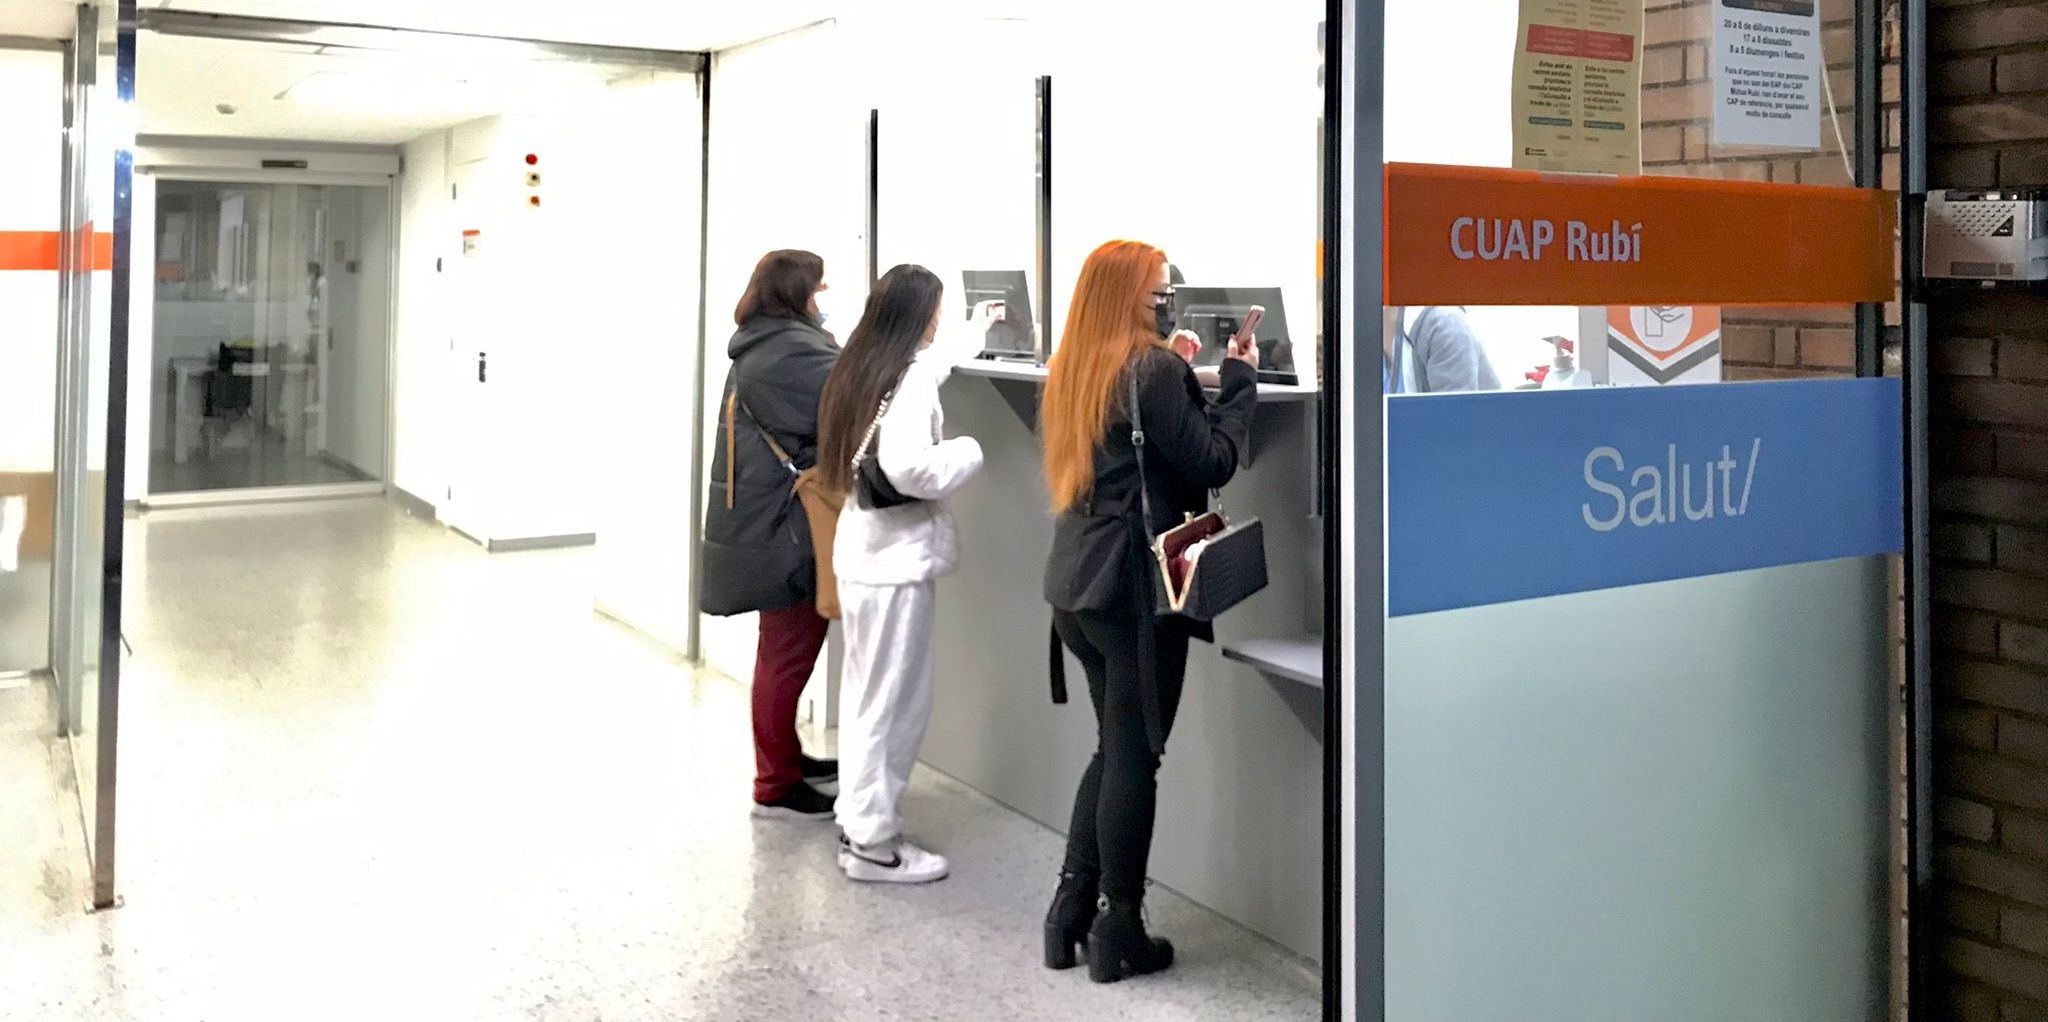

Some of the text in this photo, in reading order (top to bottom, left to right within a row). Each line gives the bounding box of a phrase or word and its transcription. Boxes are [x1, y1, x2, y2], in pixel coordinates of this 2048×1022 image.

[1724, 19, 1732, 28] 20
[1753, 23, 1773, 32] dilluns
[1780, 26, 1810, 36] divendres
[1744, 34, 1750, 42] 17
[1762, 37, 1792, 46] dissabtes
[1746, 47, 1779, 58] diumenges
[1450, 216, 1643, 262] CUAP Rubí
